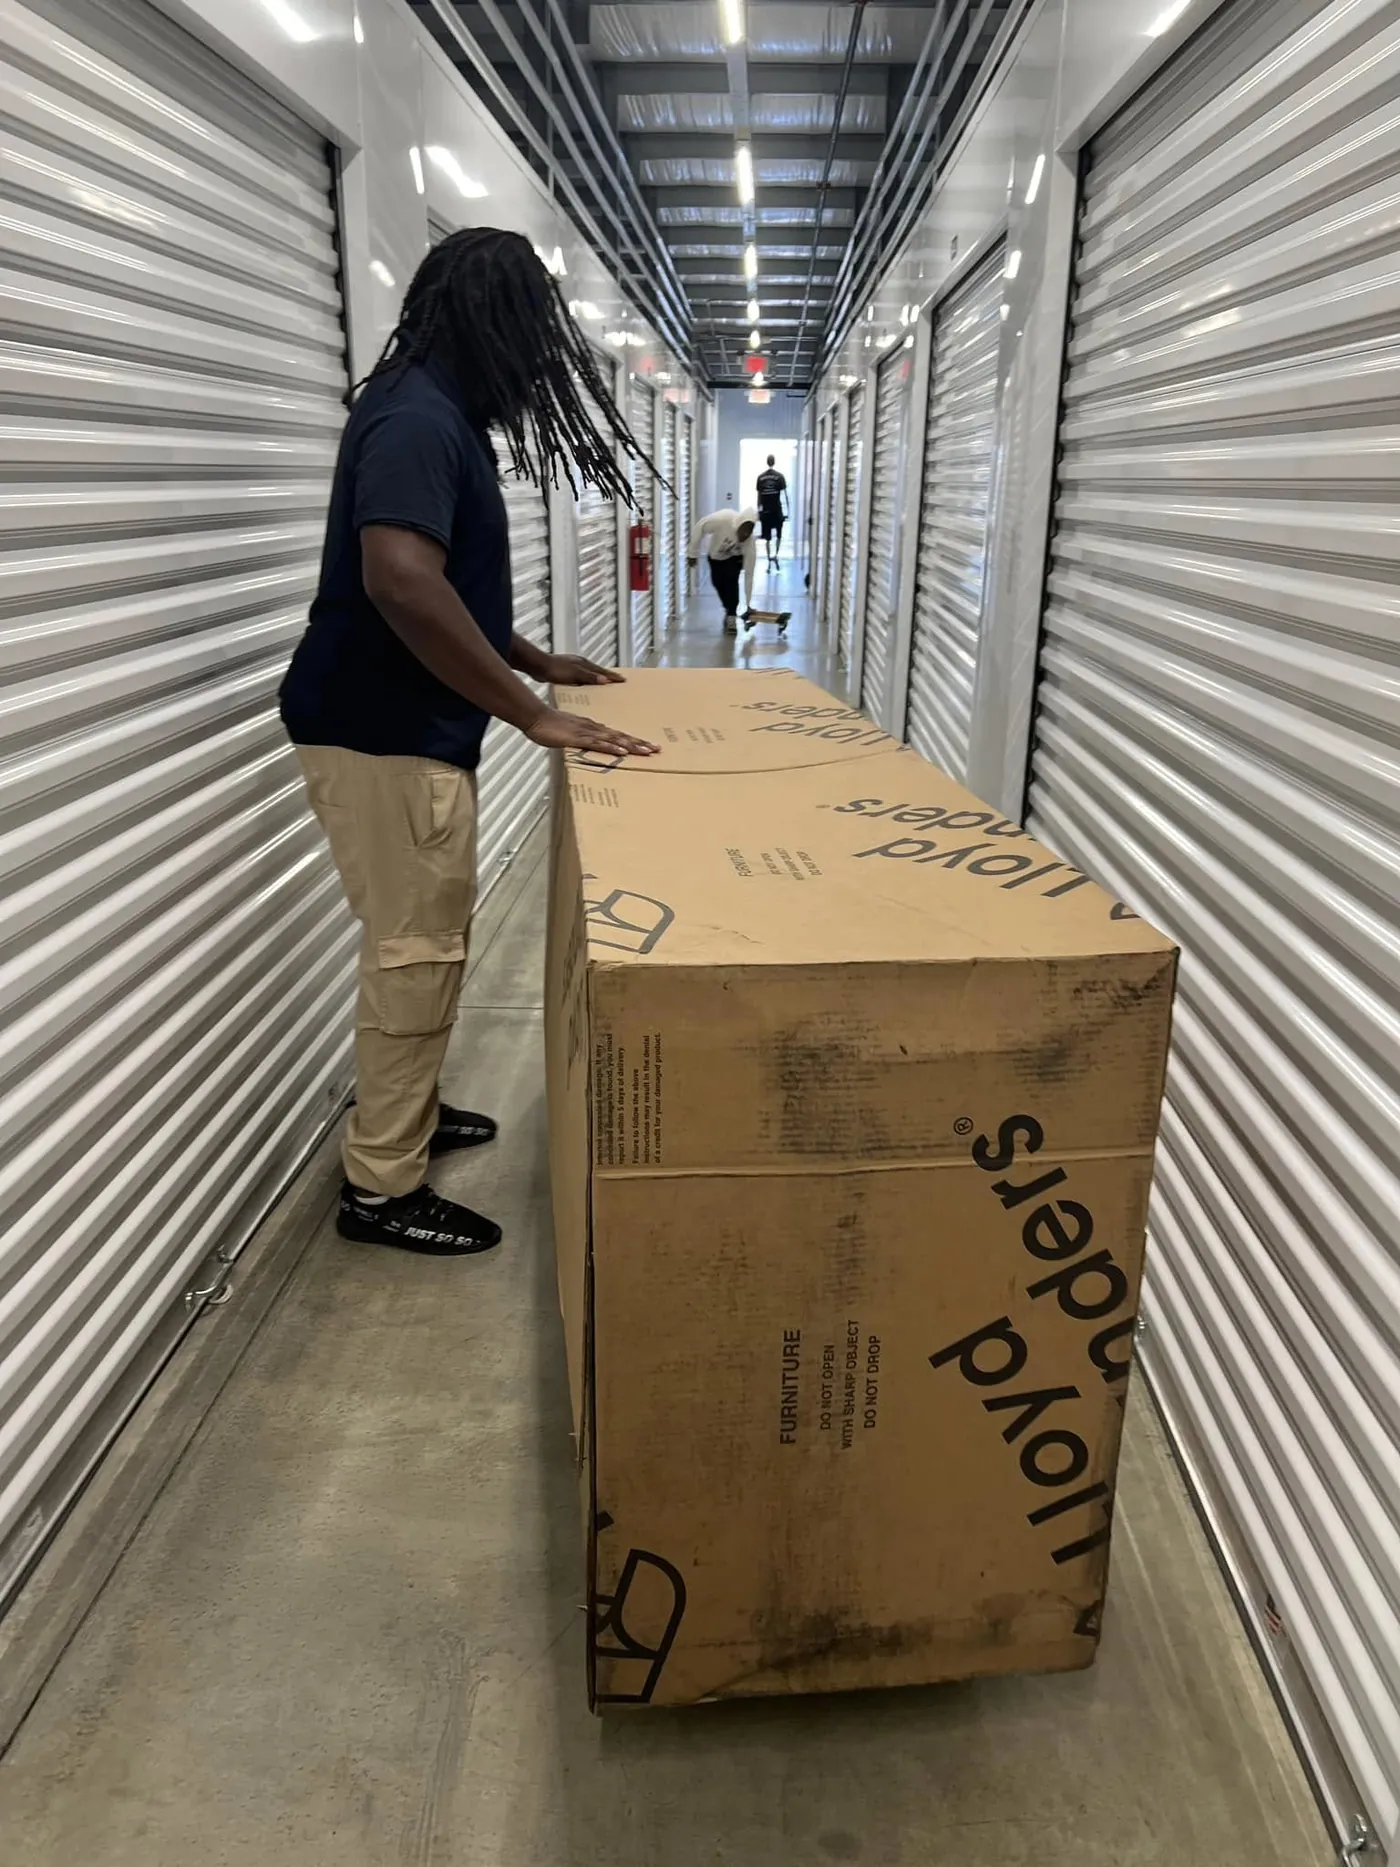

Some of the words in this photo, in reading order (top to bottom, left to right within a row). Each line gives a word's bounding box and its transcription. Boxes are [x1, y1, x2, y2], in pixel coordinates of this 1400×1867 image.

[833, 798, 1037, 841] nders
[852, 837, 1094, 898] Lloyd
[644, 1072, 649, 1080] in
[404, 1226, 437, 1241] JUST
[435, 1233, 454, 1243] SO
[454, 1236, 473, 1247] SO
[953, 1113, 1136, 1404] nders®
[823, 1345, 834, 1379] OPEN
[846, 1320, 858, 1369] OBJECT
[868, 1336, 881, 1373] DROP
[780, 1330, 800, 1444] FURNITURE
[821, 1384, 833, 1408] NOT
[844, 1373, 856, 1415] SHARP
[866, 1378, 878, 1406] NOT
[820, 1412, 831, 1430] DO
[841, 1419, 853, 1449] WITH
[864, 1409, 876, 1428] DO
[928, 1315, 1112, 1566] Lloyd
